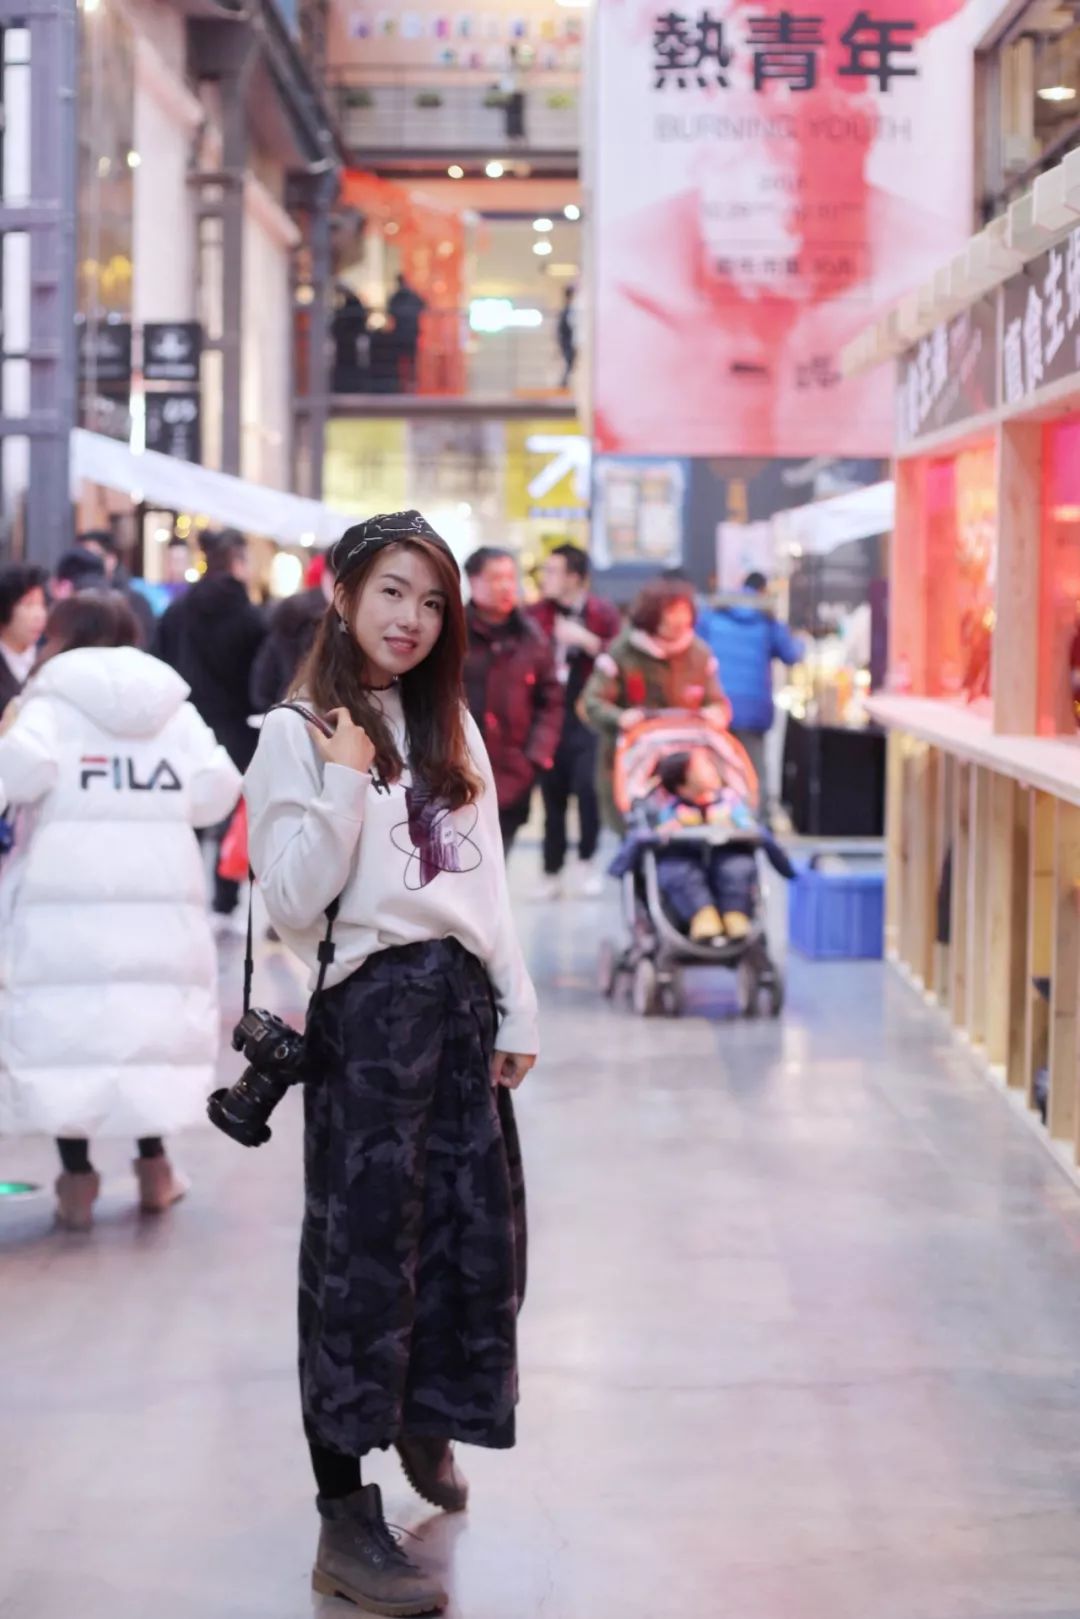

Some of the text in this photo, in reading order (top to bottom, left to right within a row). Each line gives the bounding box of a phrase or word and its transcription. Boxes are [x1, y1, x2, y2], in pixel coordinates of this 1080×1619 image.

[653, 10, 918, 92] 熱青年
[654, 114, 912, 142] BURNING YOUTH
[80, 756, 182, 790] FILA
